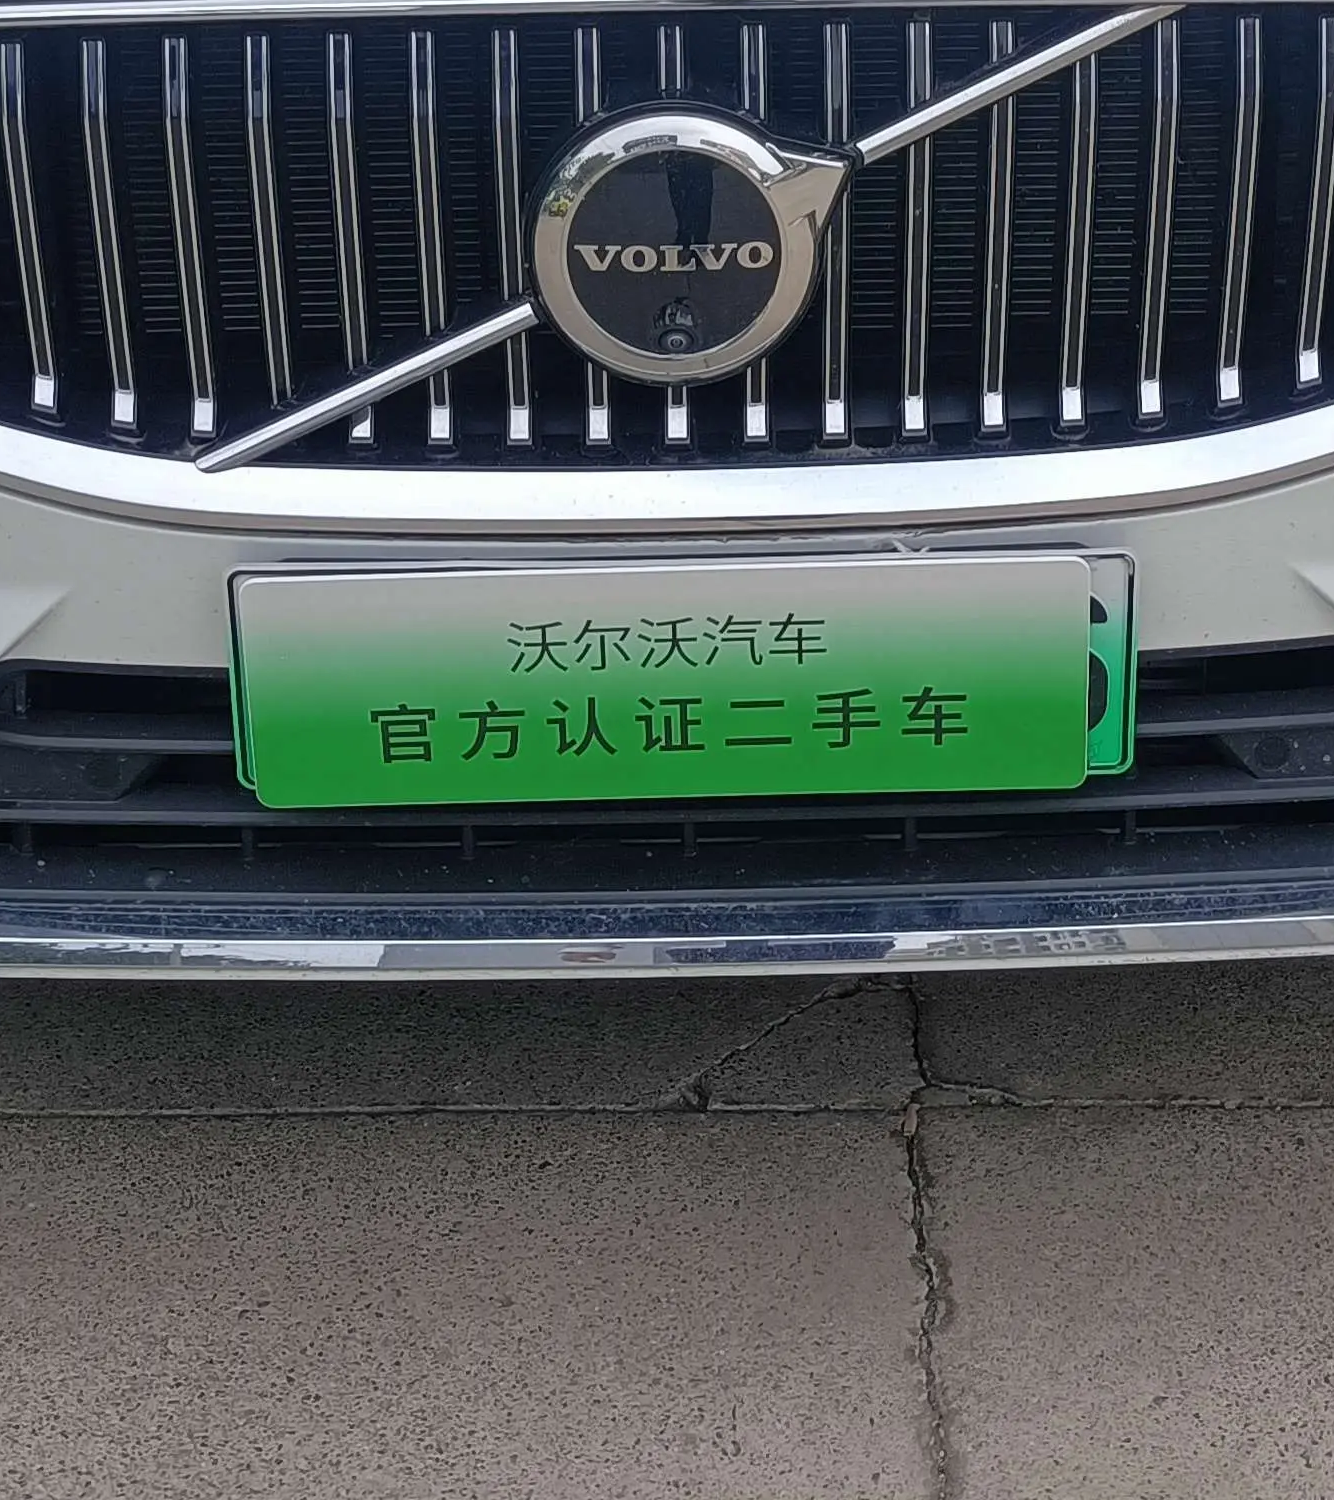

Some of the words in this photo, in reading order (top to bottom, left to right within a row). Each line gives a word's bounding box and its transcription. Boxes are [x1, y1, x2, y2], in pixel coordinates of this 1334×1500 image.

[573, 241, 774, 273] VOLVO
[507, 612, 828, 674] 沃尔沃汽车
[369, 686, 969, 764] 官方认证二手车
